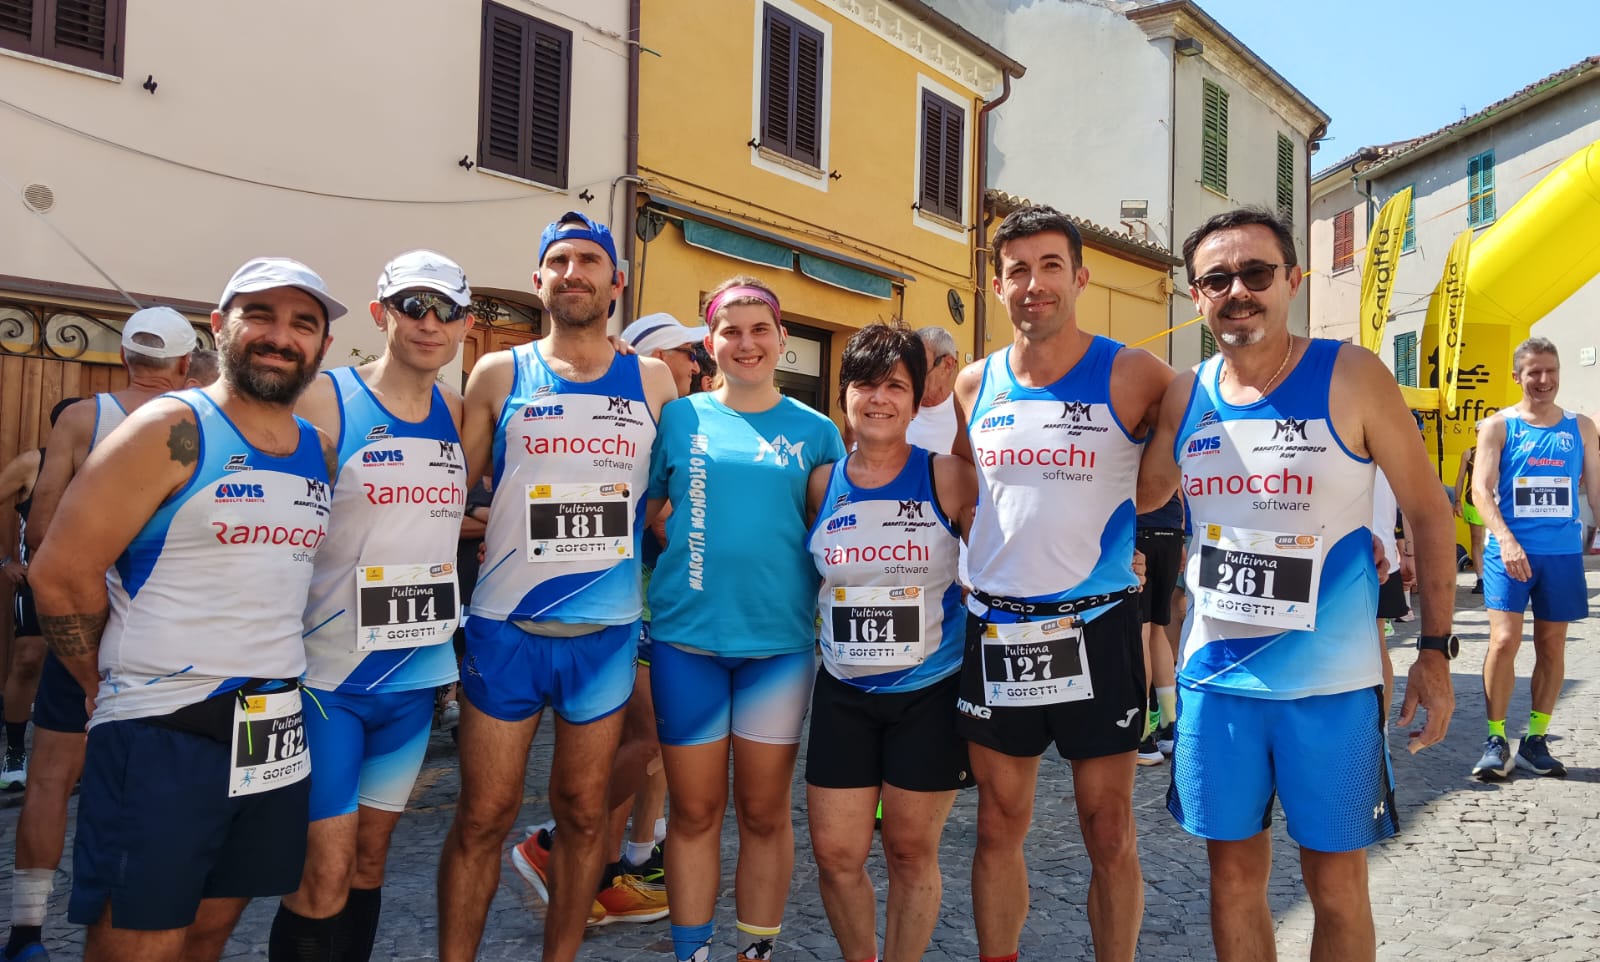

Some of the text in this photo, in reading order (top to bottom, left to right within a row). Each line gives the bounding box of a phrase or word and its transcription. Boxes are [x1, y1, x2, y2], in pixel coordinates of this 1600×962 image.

[523, 405, 564, 418] AVIS
[981, 414, 1015, 429] AVIS
[522, 434, 636, 458] Ranocchi
[1188, 436, 1221, 453] AVIS
[362, 449, 404, 463] AVIS
[593, 458, 633, 470] software
[977, 443, 1096, 468] Ranocchi
[1042, 469, 1093, 482] software
[1184, 468, 1313, 496] Ranocchi
[215, 484, 265, 498] AVIS
[363, 481, 464, 505] Ranocchi
[1530, 493, 1557, 506] 141
[559, 503, 604, 514] l'ultima
[688, 434, 709, 592] MAROTTA MONDOLFO RUN
[1252, 498, 1311, 511] software
[555, 514, 605, 539] 181
[826, 514, 857, 531] AVIS
[824, 539, 929, 566] Ranocchi
[1225, 551, 1278, 569] l'ultima
[884, 564, 929, 574] software
[1216, 563, 1276, 599] 261
[391, 586, 434, 598] l'ultima
[387, 596, 437, 624] 114
[851, 607, 893, 618] l'ultima
[849, 618, 897, 643] 164
[1005, 644, 1050, 656] l'ultima
[1003, 655, 1053, 682] 127
[265, 725, 304, 763] 182
